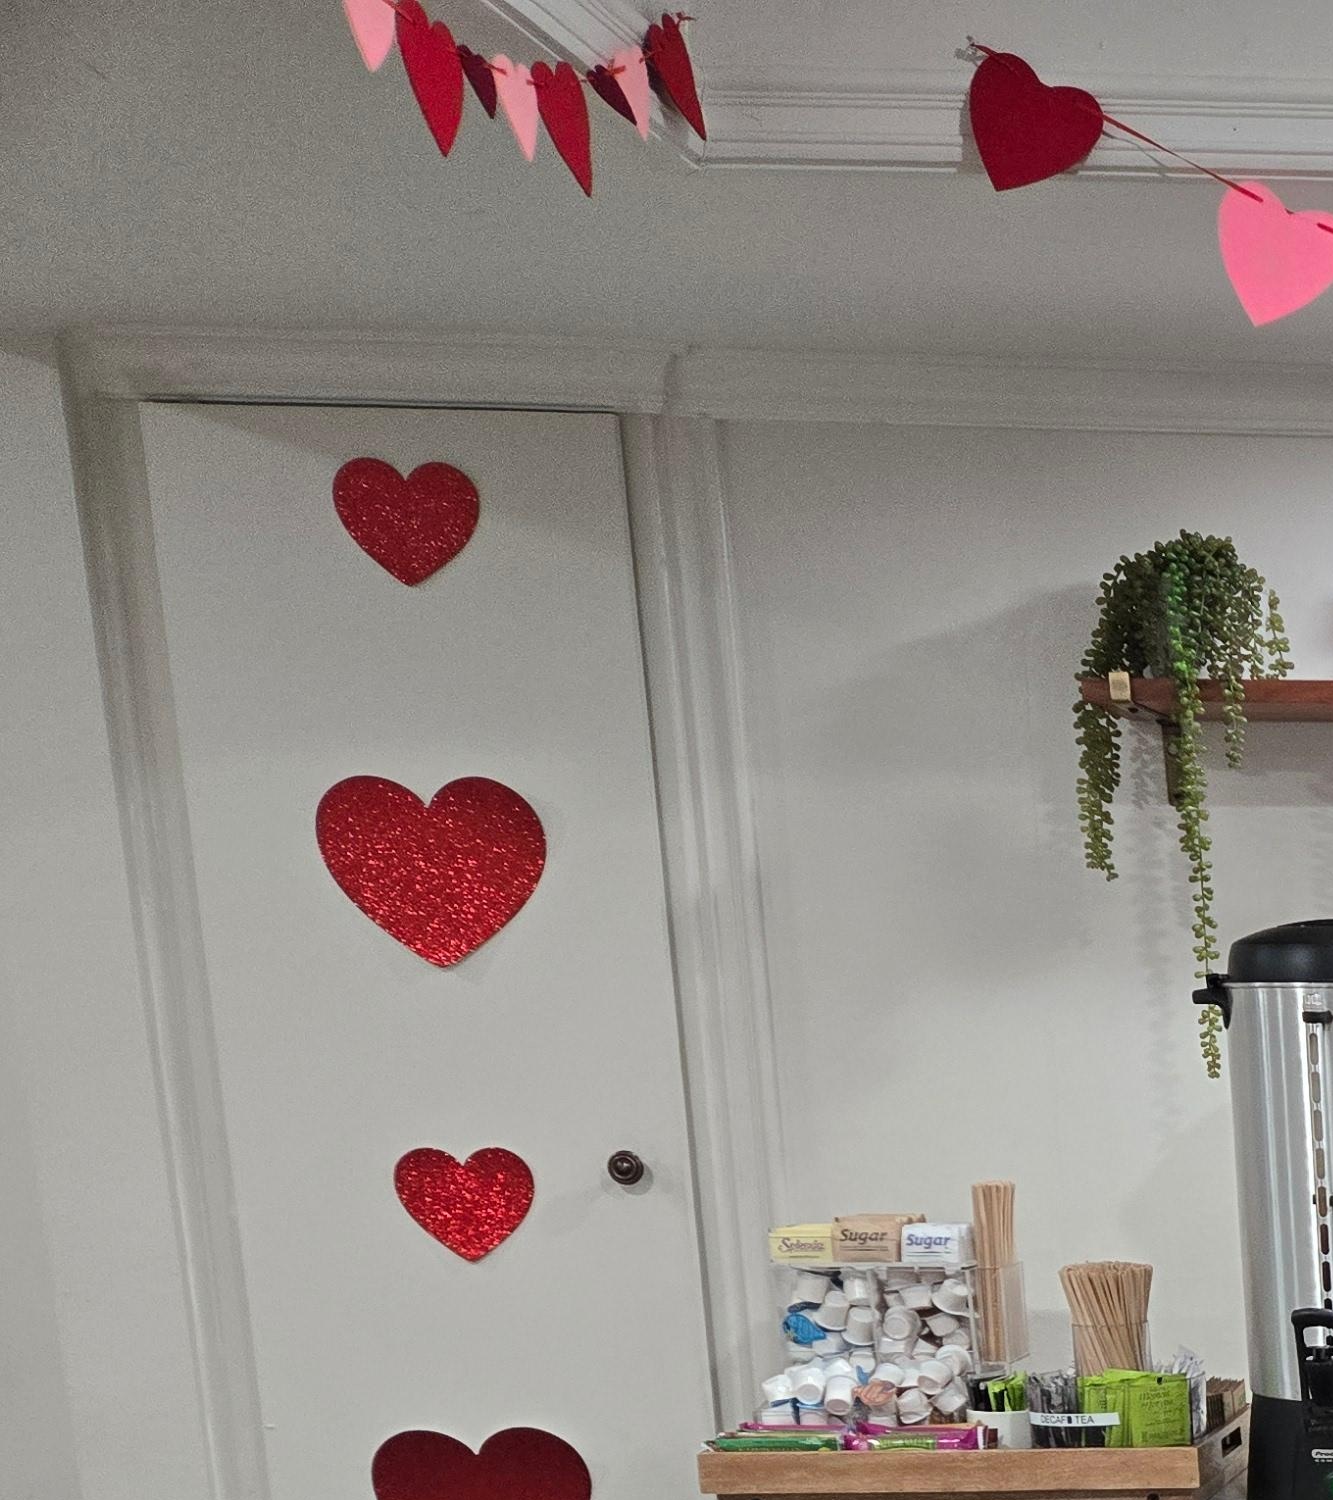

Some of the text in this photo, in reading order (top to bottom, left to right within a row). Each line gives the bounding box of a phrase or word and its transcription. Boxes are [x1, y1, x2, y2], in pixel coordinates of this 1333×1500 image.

[839, 1228, 887, 1245] Sugar
[905, 1233, 950, 1250] Sugar
[1075, 1415, 1096, 1425] TEA
